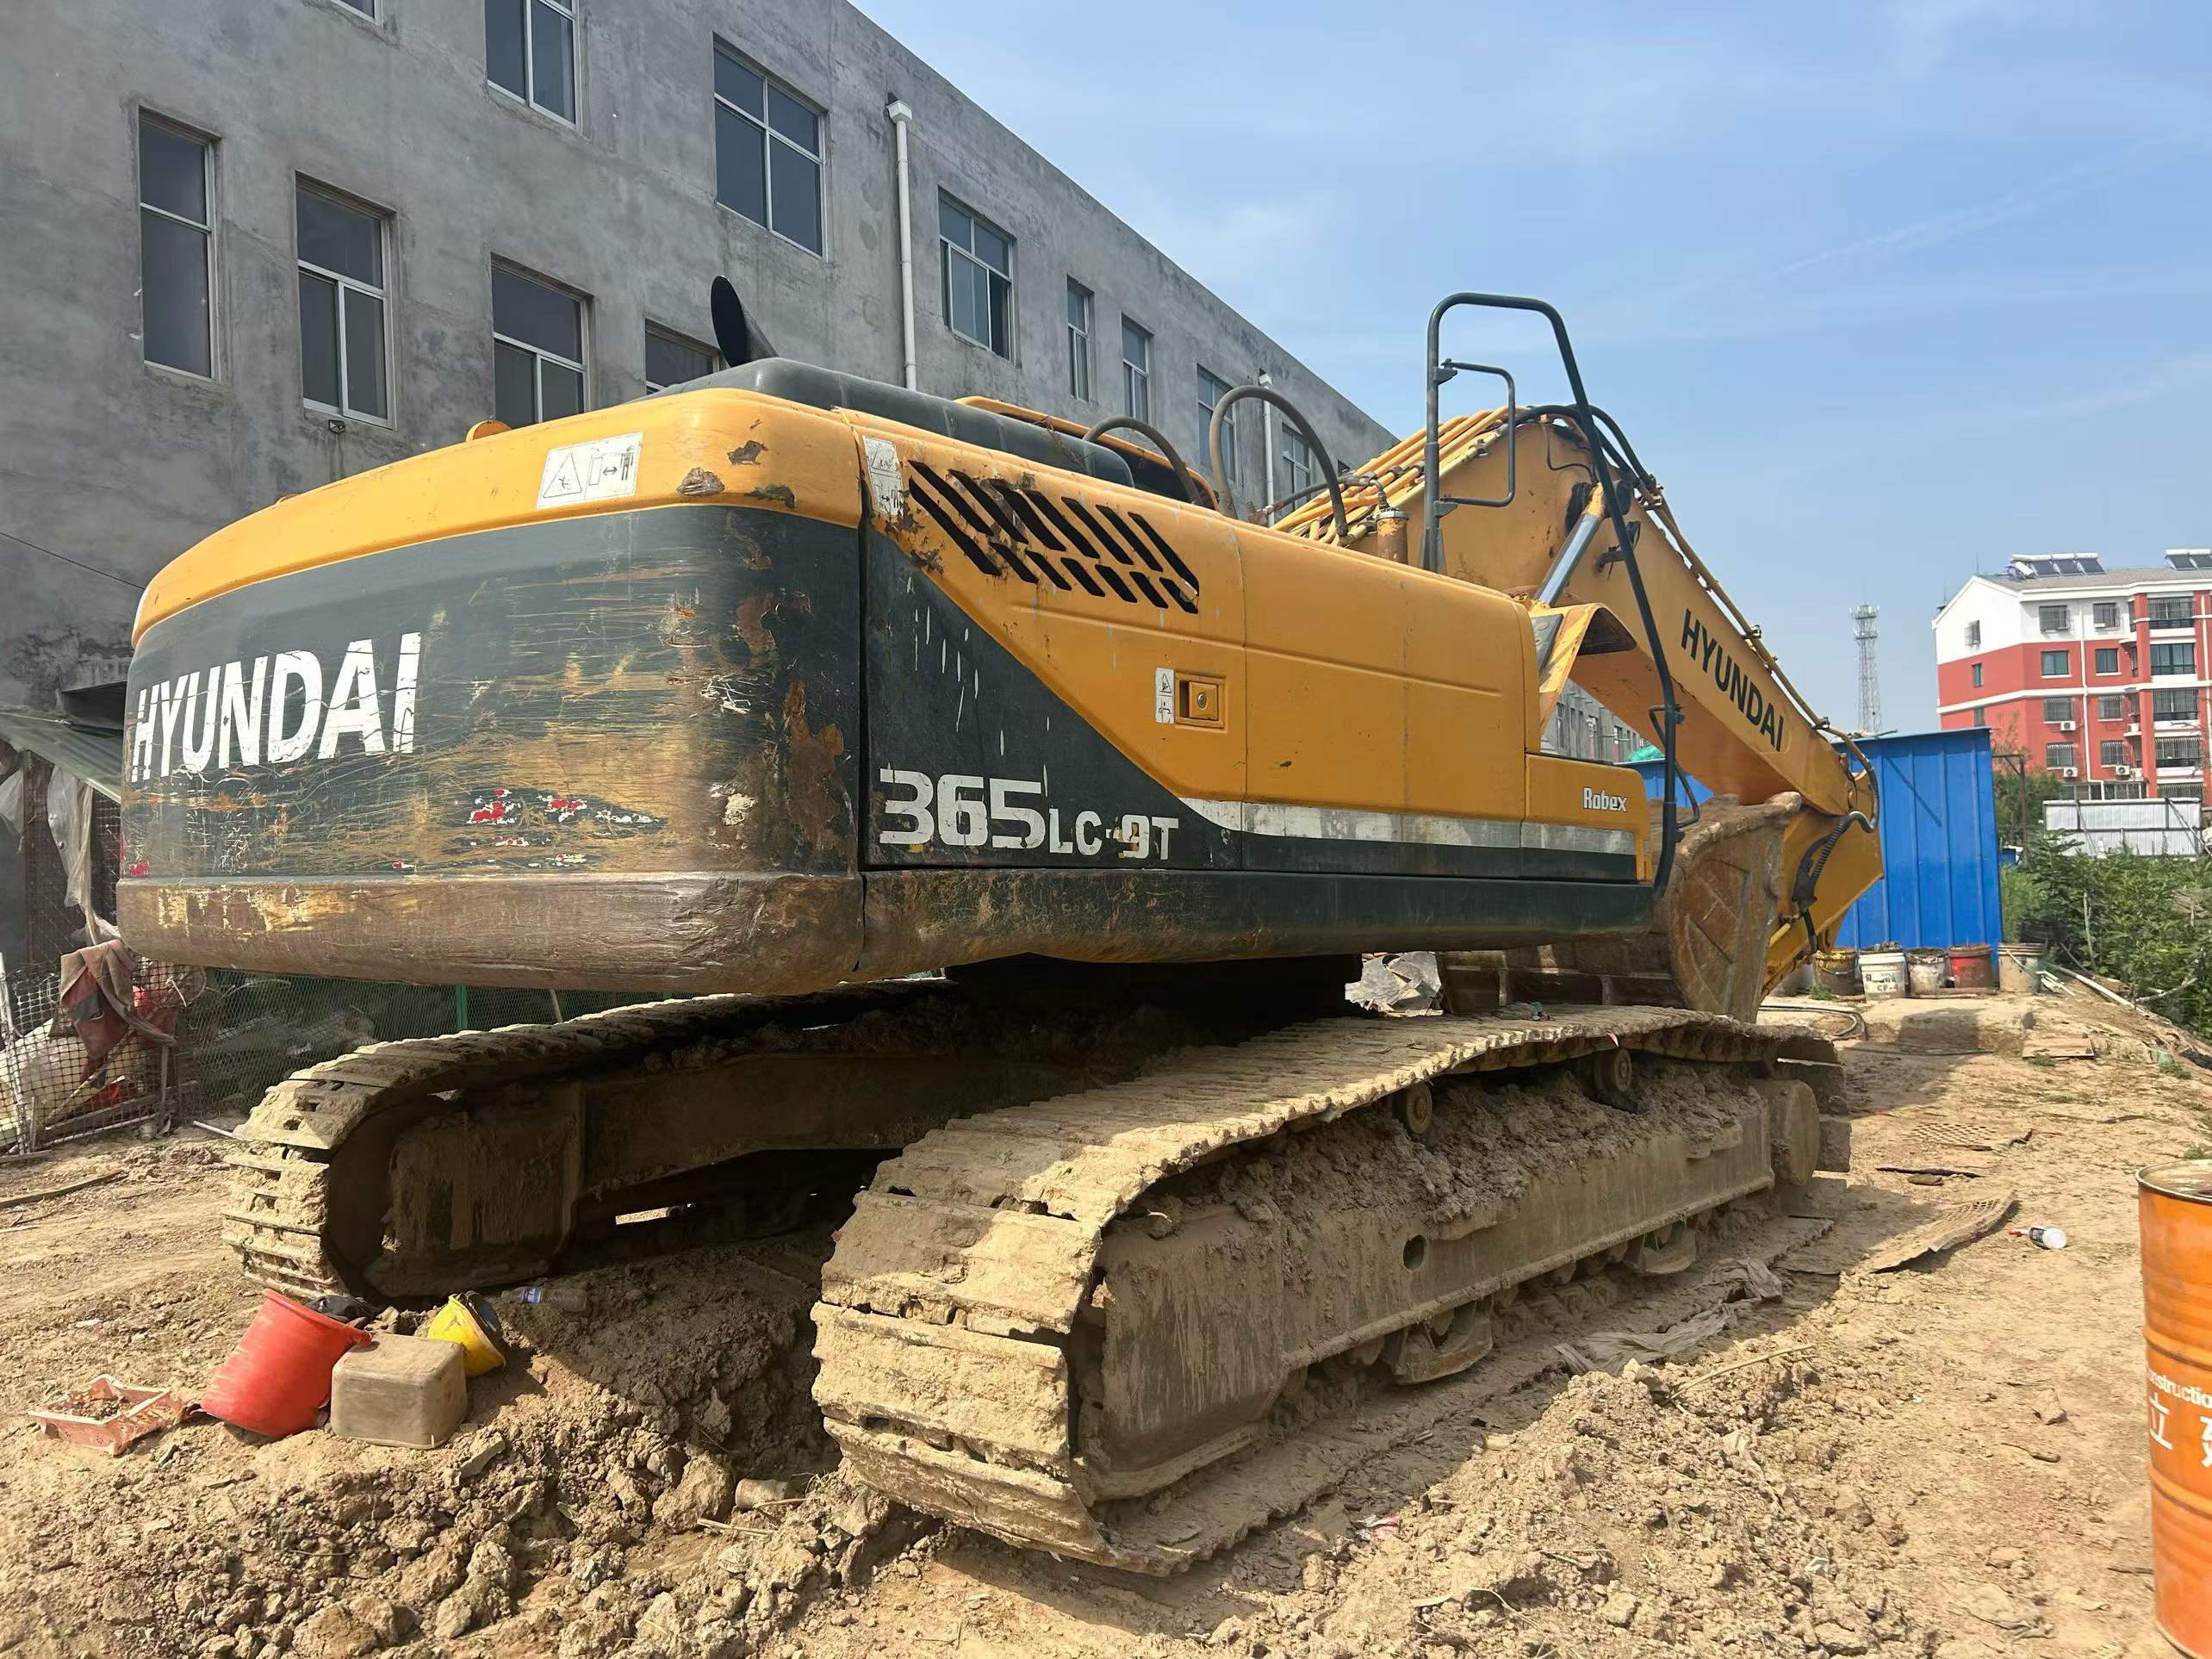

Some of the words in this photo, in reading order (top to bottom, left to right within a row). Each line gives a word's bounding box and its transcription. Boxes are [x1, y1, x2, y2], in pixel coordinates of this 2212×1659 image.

[132, 631, 422, 783] HYUNDAI
[1681, 607, 1784, 752] HYUNDAI
[1582, 786, 1628, 812] Robex
